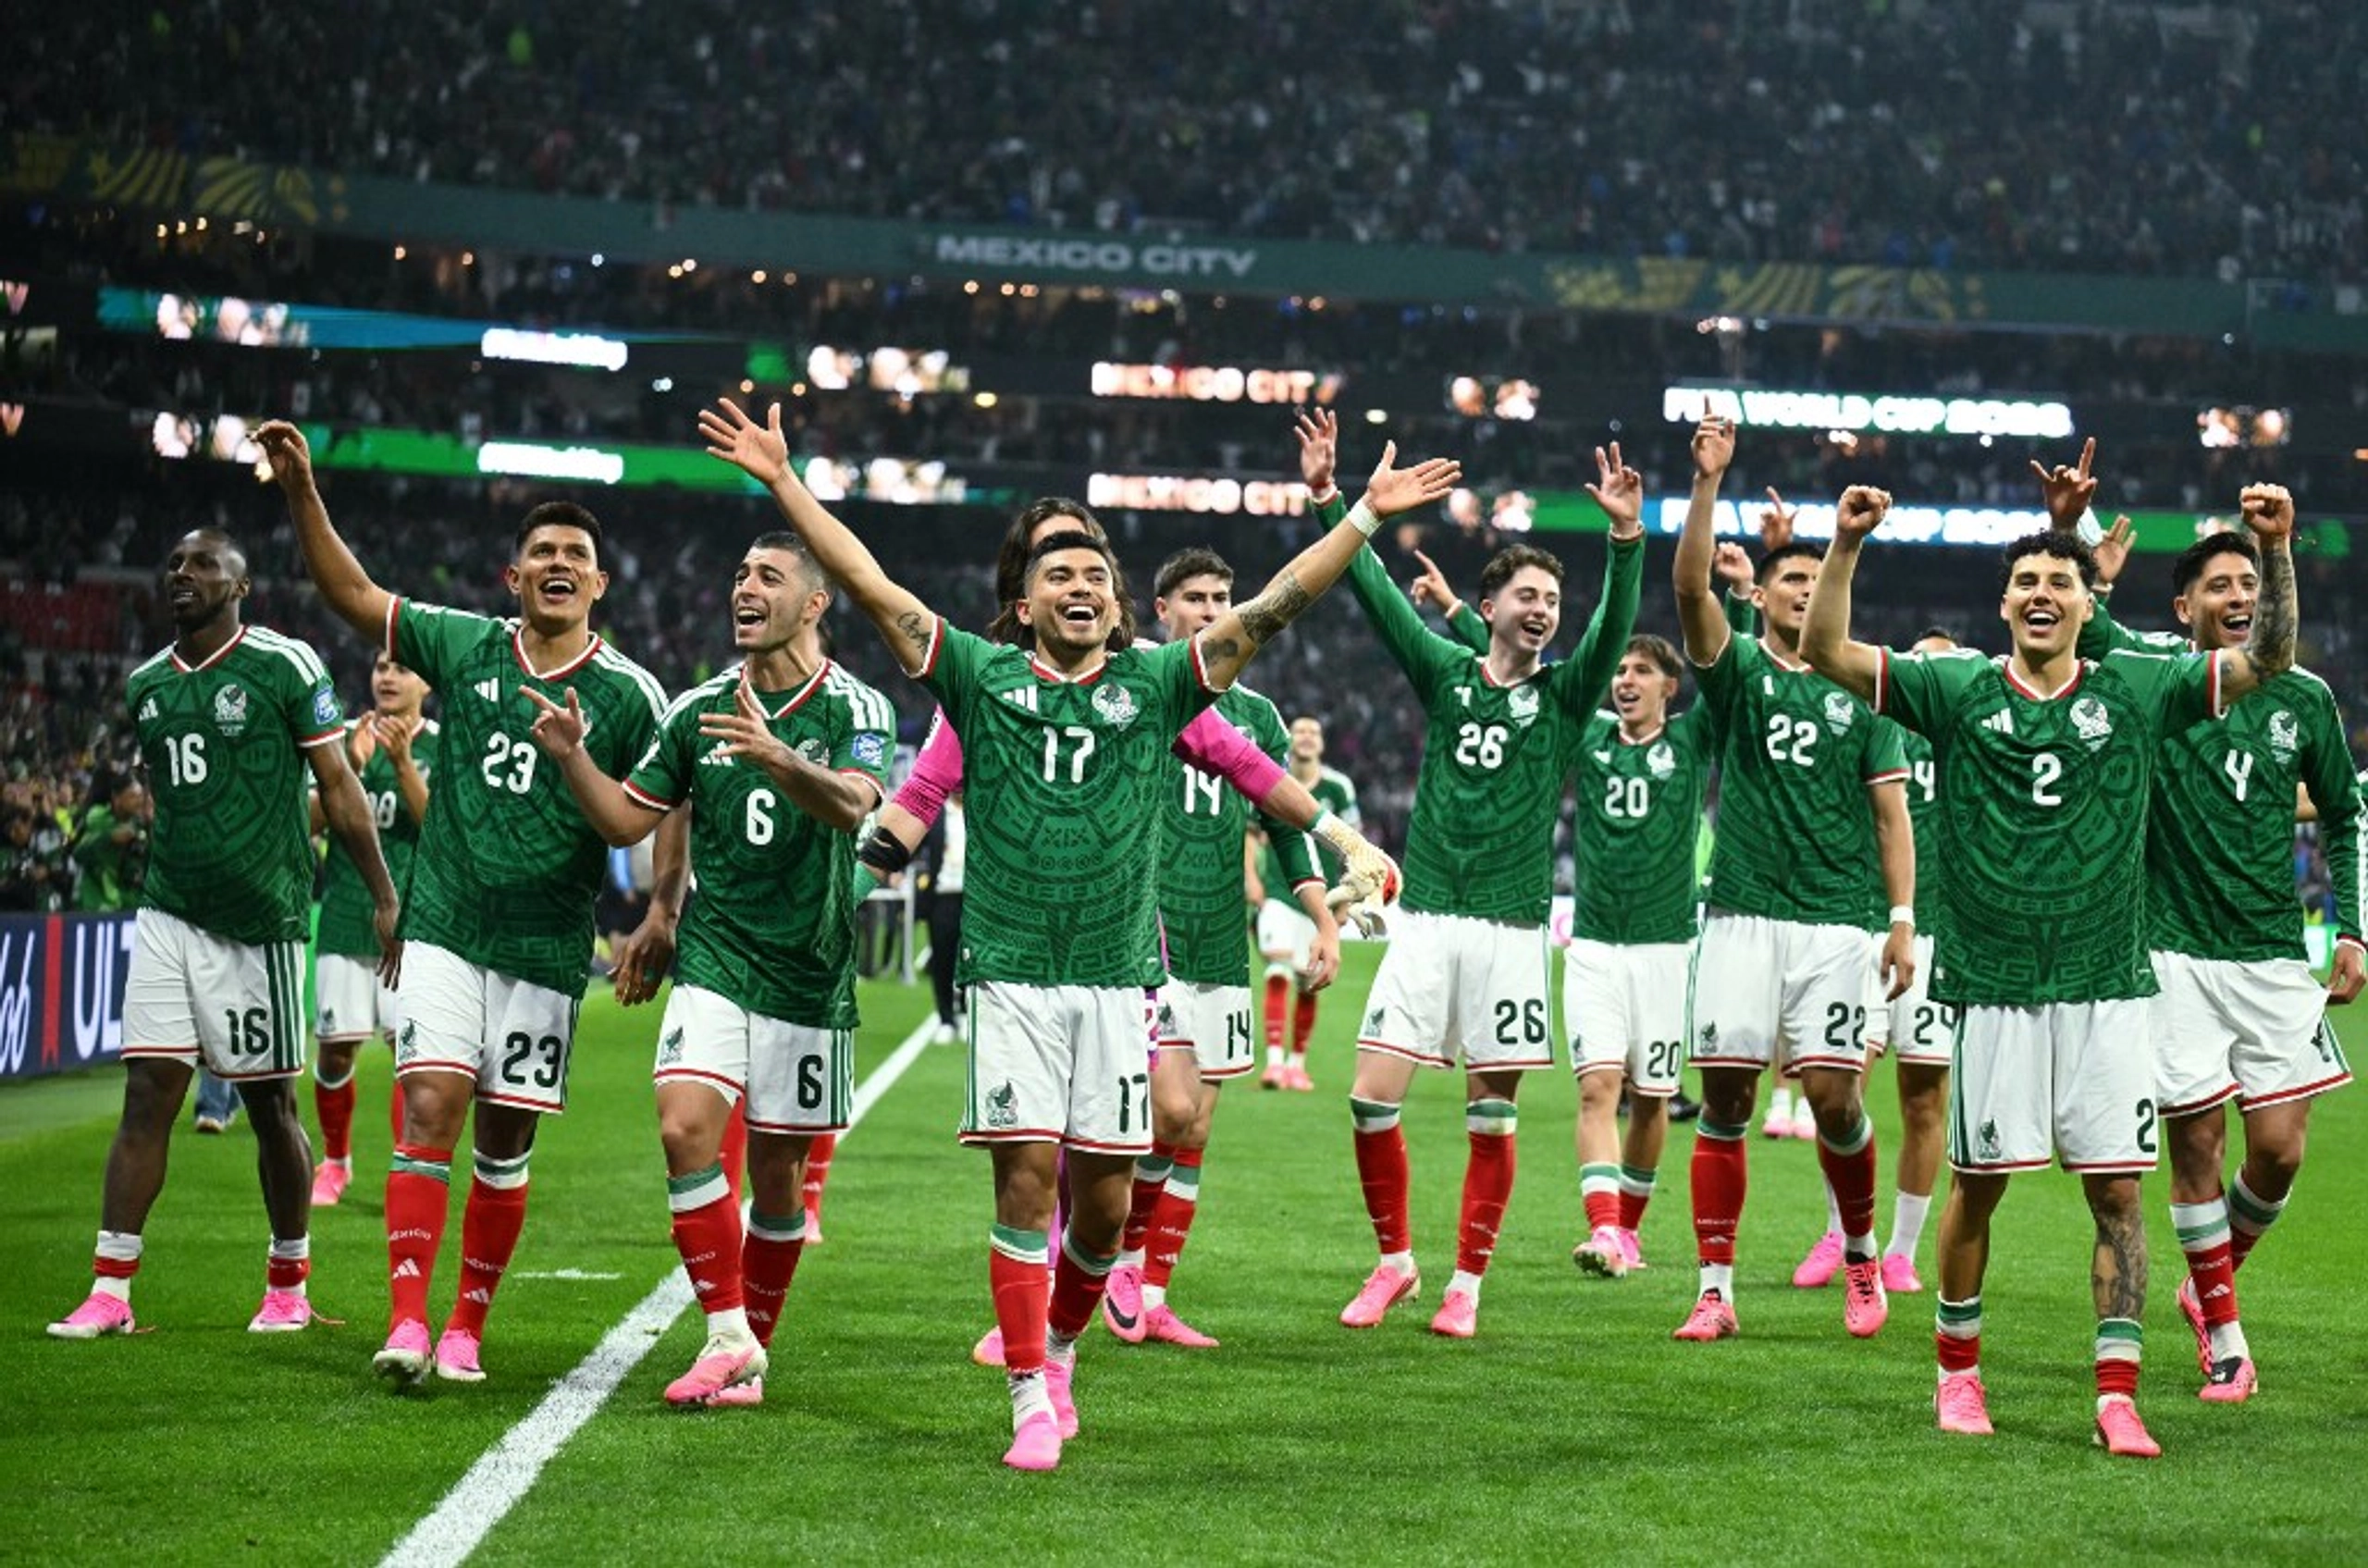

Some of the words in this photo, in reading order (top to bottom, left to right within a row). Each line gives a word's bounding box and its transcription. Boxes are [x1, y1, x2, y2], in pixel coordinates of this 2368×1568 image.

[936, 235, 1133, 271] MEXICO
[1140, 244, 1256, 277] CITY
[165, 733, 208, 787] 16
[482, 731, 538, 795] 23
[1042, 725, 1095, 784] 17
[1455, 722, 1509, 770] 26
[1766, 713, 1818, 767] 22
[1182, 763, 1223, 816] 14
[1604, 775, 1649, 819] 20
[2032, 752, 2063, 807] 2
[2224, 748, 2253, 801] 4
[746, 788, 776, 846] 6
[226, 1007, 270, 1056] 16
[1226, 1008, 1251, 1060] 14
[1494, 998, 1546, 1045] 26
[500, 1031, 562, 1089] 23
[797, 1054, 823, 1109] 6
[1118, 1073, 1148, 1134] 17
[2136, 1098, 2157, 1153] 2
